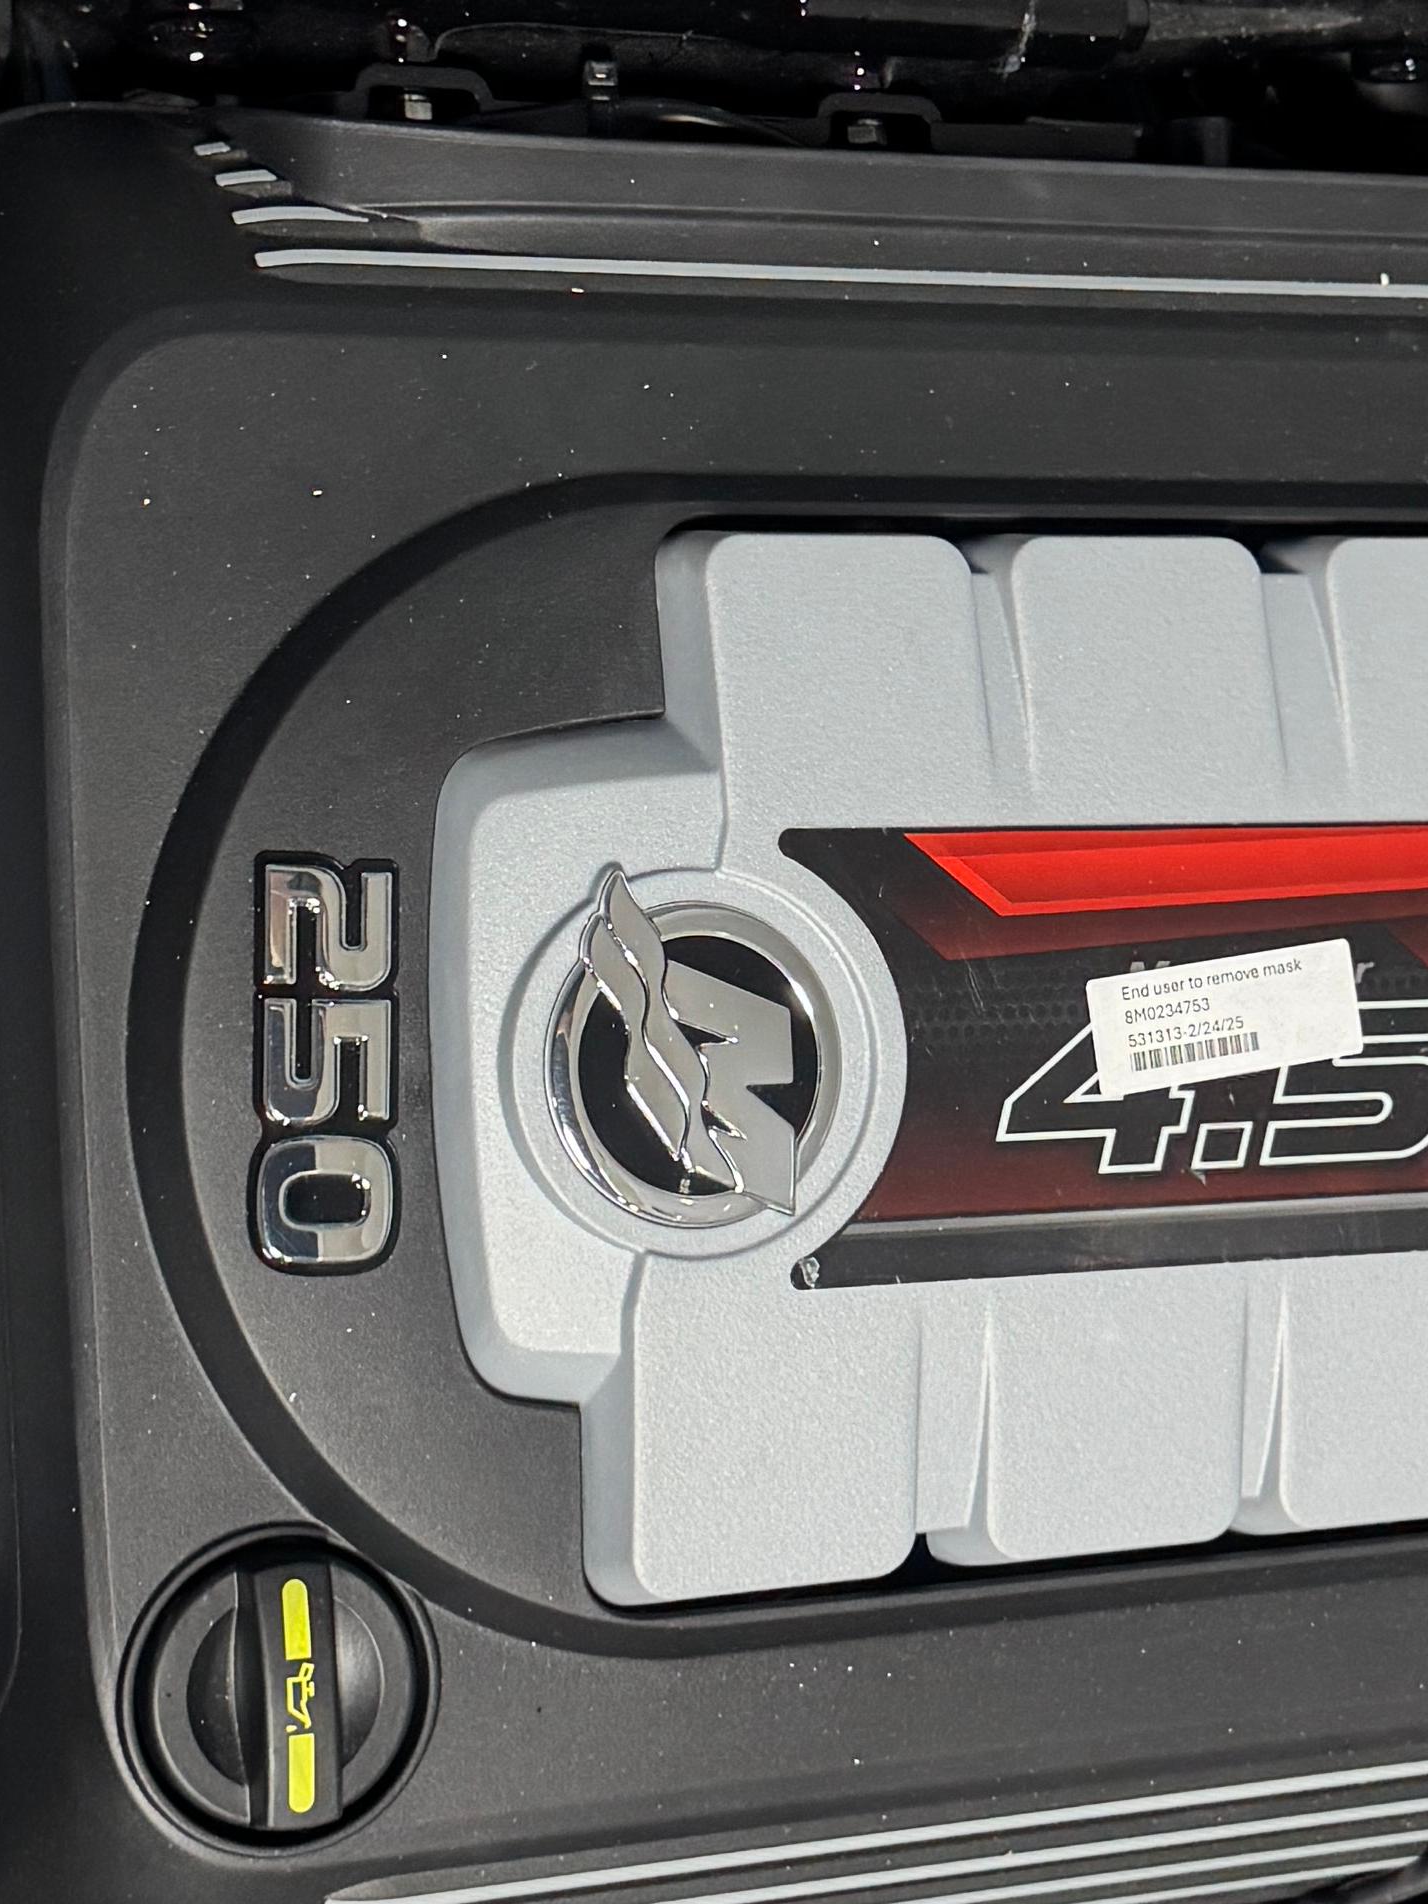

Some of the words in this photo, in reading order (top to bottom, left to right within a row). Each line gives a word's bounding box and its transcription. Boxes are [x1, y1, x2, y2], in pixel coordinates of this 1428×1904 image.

[1121, 982, 1150, 1001] End
[1153, 979, 1185, 995] user
[1188, 976, 1203, 991] to
[1206, 966, 1260, 987] remove
[1262, 958, 1303, 976] mask
[1124, 997, 1211, 1025] 8M0234753
[255, 861, 396, 1267] 250
